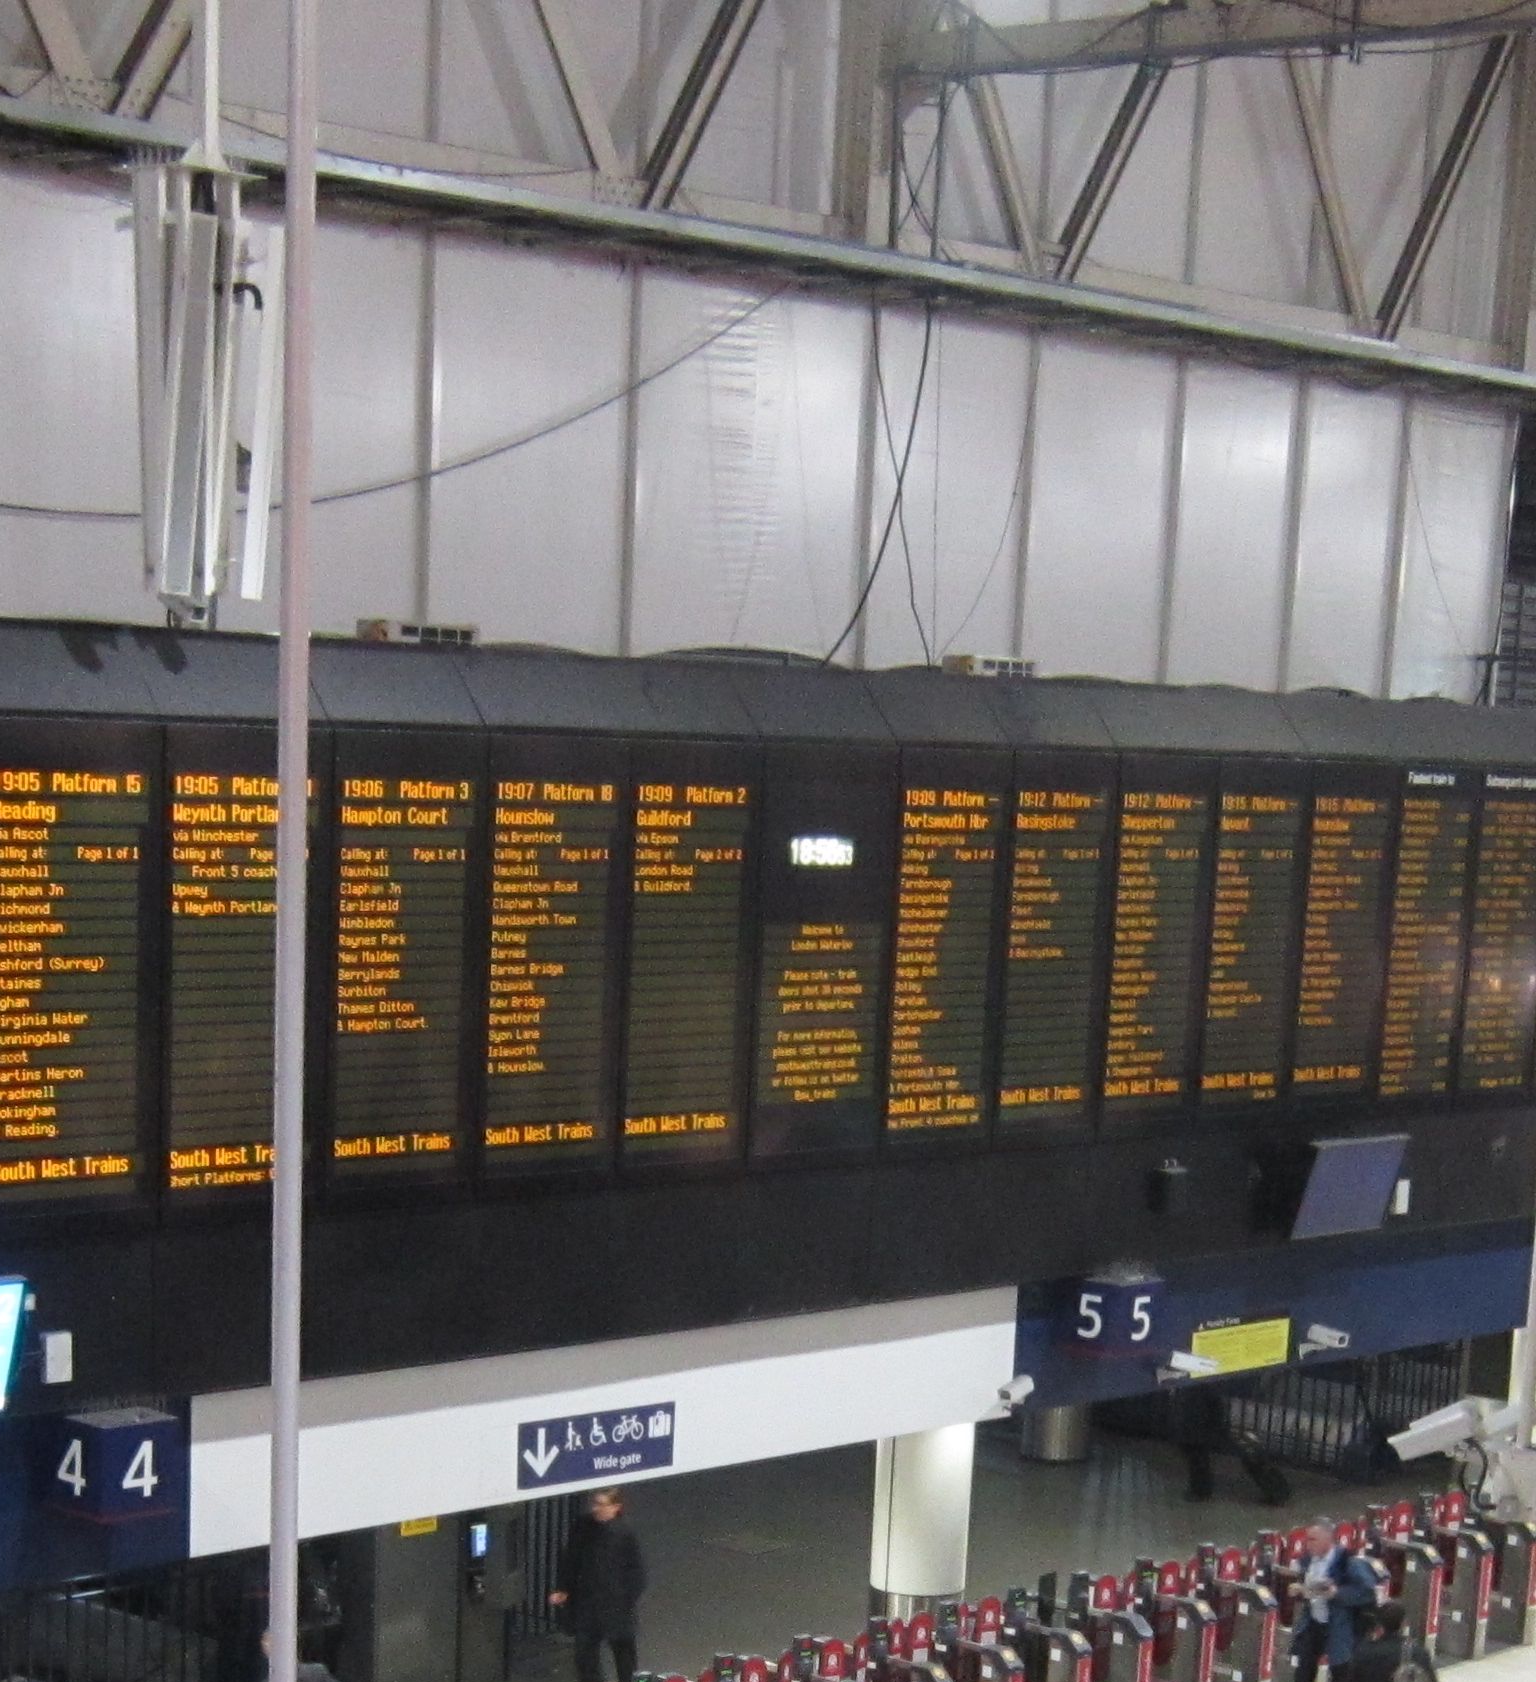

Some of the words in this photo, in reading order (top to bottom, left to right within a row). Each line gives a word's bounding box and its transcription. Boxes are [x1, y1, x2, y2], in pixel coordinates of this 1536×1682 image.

[53, 773, 117, 792] Platform
[126, 775, 140, 793] 15
[346, 780, 383, 797] 19:06
[400, 781, 454, 798] Platform
[460, 783, 468, 799] 3
[499, 783, 533, 799] 19:07
[544, 784, 594, 800] Platform
[687, 787, 733, 803] Platform
[738, 788, 746, 803] 2
[342, 807, 401, 826] Hampton
[408, 807, 447, 824] Court
[496, 808, 554, 824] Hounslow
[637, 810, 691, 826] Guildford
[904, 813, 965, 828] Portsmouth
[970, 814, 988, 828] Hbr
[335, 1138, 371, 1156] South
[376, 1136, 405, 1153] West
[413, 1134, 450, 1150] Trains
[42, 1158, 76, 1177] West
[85, 1156, 128, 1174] Trains
[1077, 1295, 1104, 1340] 5
[1129, 1296, 1152, 1341] 5
[56, 1440, 86, 1496] 4
[122, 1440, 159, 1497] 4
[594, 1456, 617, 1469] Wide
[620, 1454, 641, 1469] gate
